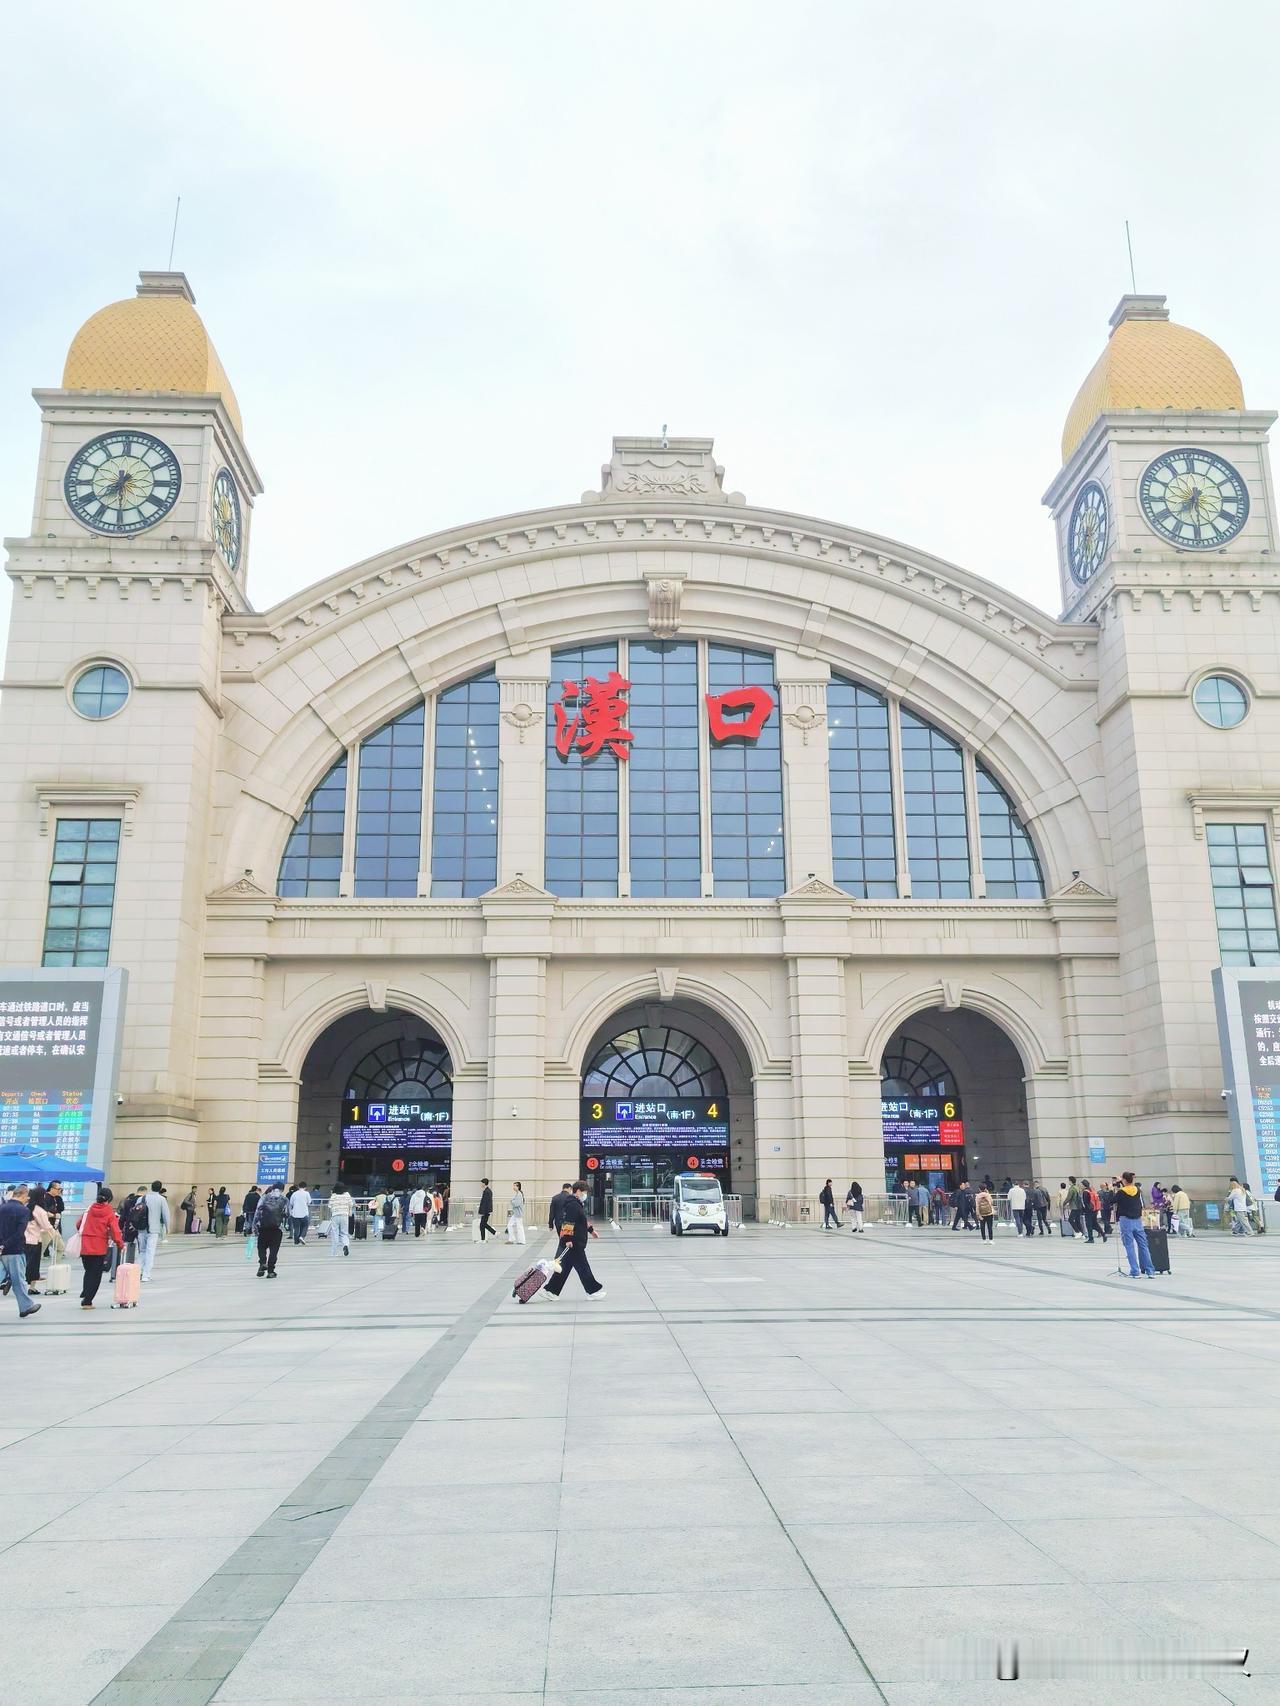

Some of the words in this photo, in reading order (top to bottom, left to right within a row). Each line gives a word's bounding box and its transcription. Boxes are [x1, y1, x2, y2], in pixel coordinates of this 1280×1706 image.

[553, 672, 774, 760] 漢口
[351, 1105, 360, 1121] 1
[388, 1104, 420, 1115] 进站口
[592, 1103, 603, 1119] 3
[634, 1103, 666, 1113] 进站口
[707, 1103, 718, 1118] 4
[944, 1102, 955, 1118] 6
